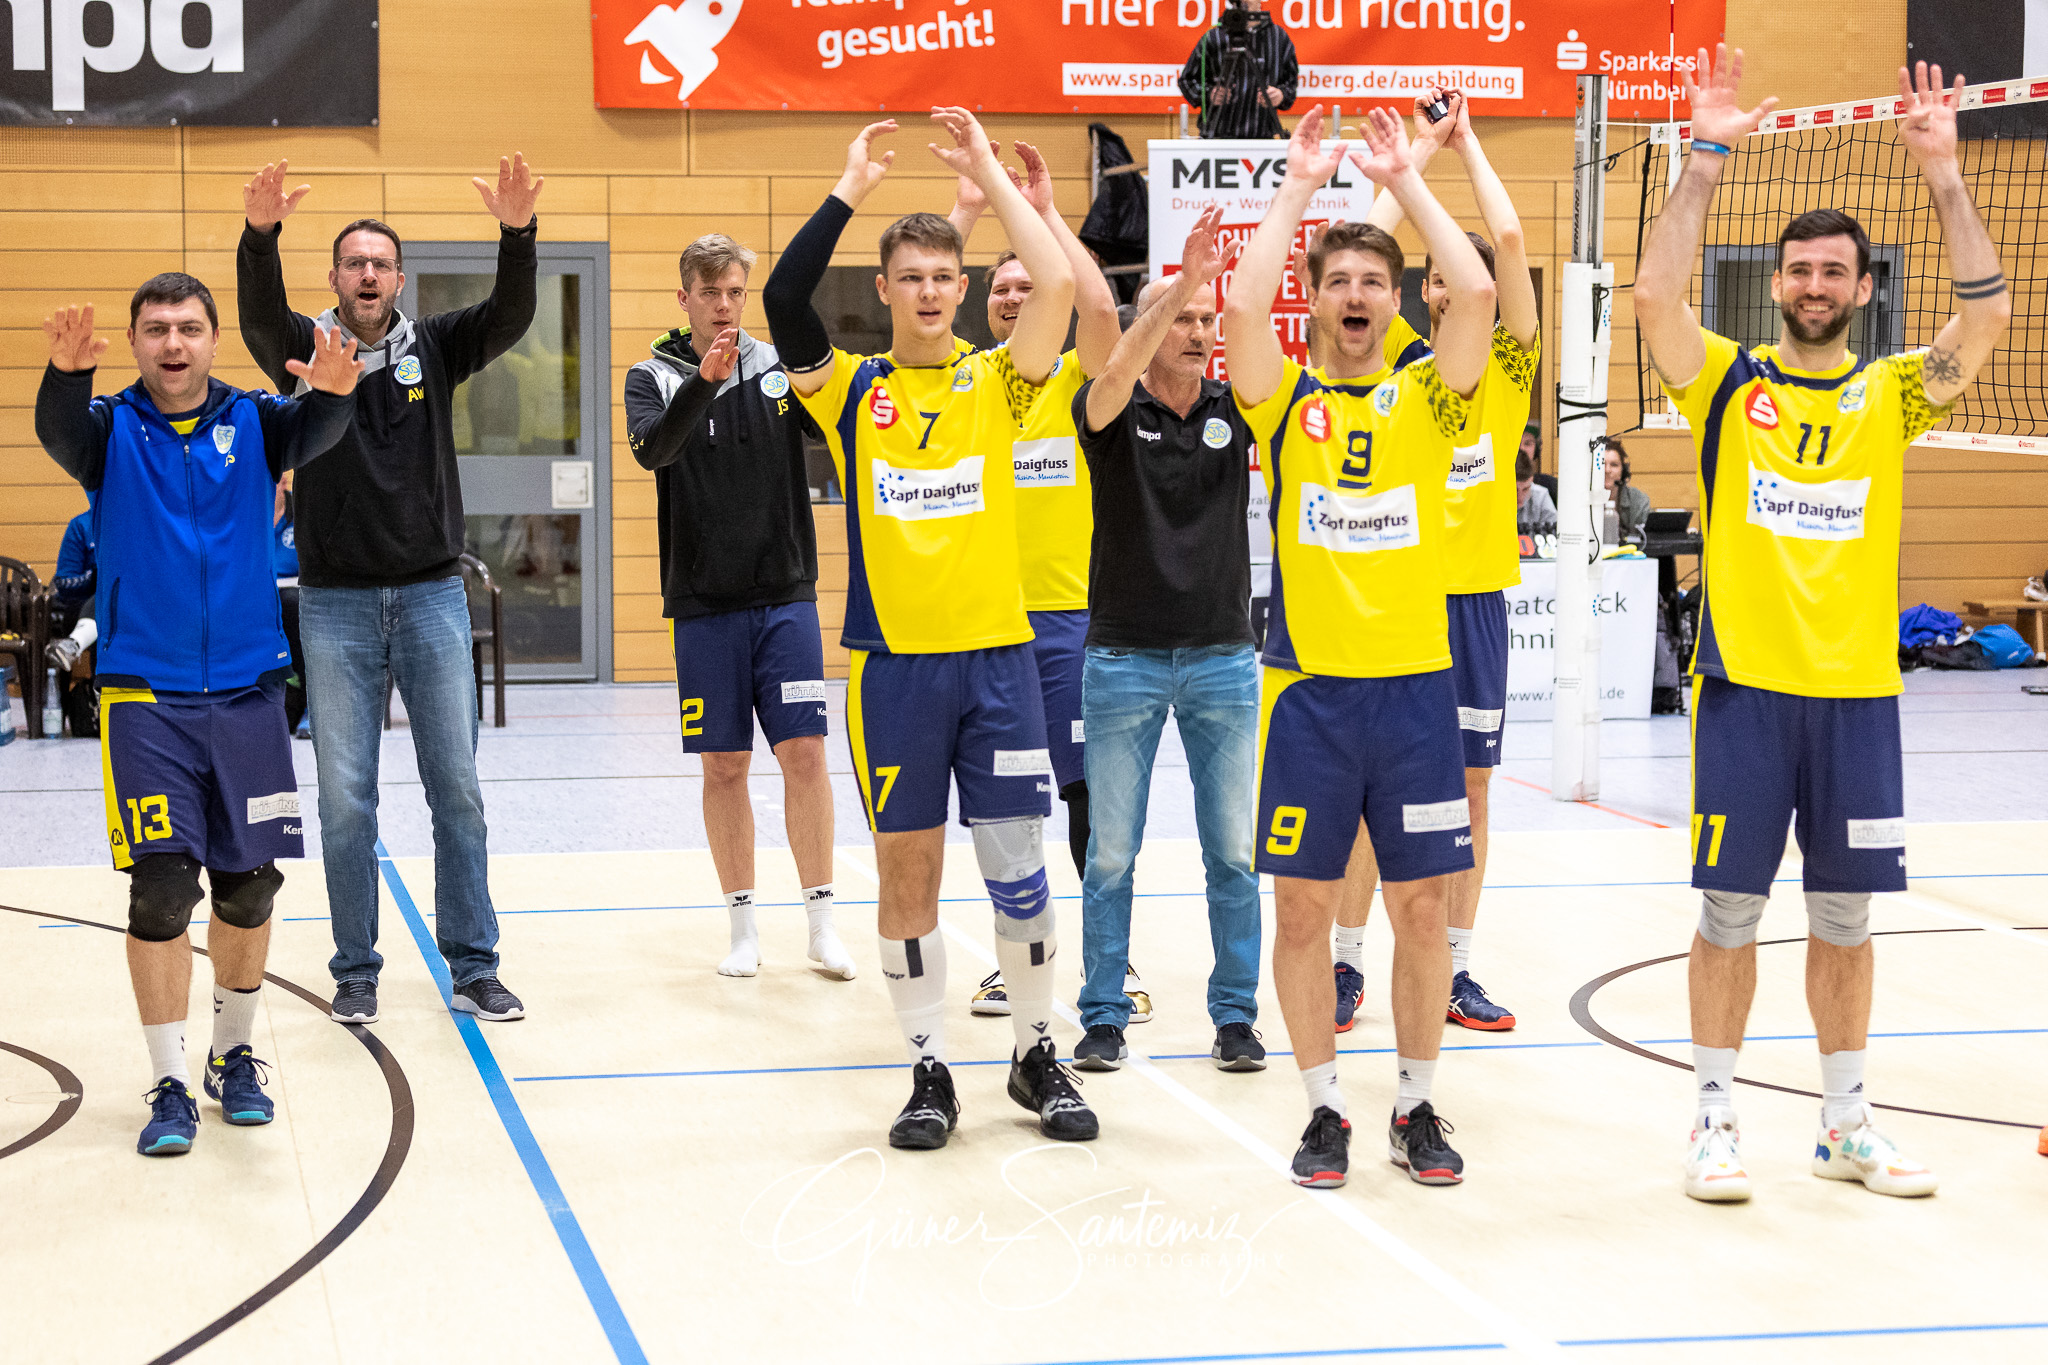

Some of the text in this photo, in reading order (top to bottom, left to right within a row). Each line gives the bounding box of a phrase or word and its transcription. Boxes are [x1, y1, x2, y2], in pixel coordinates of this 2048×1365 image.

[817, 9, 995, 69] gesucht!
[1599, 50, 1702, 76] Sparkass
[1172, 158, 1353, 189] MEYSL
[1172, 198, 1219, 210] Druck
[1573, 188, 1581, 256] ERHARD
[776, 398, 789, 416] JS
[917, 411, 941, 450] 7
[1796, 422, 1832, 466] 11
[1013, 458, 1068, 472] Daigfuss
[1341, 430, 1373, 478] 9
[1763, 498, 1794, 516] apf
[681, 697, 704, 737] 2
[875, 765, 901, 813] 7
[126, 794, 173, 844] 13
[1265, 805, 1307, 856] 9
[1692, 813, 1727, 867] 11
